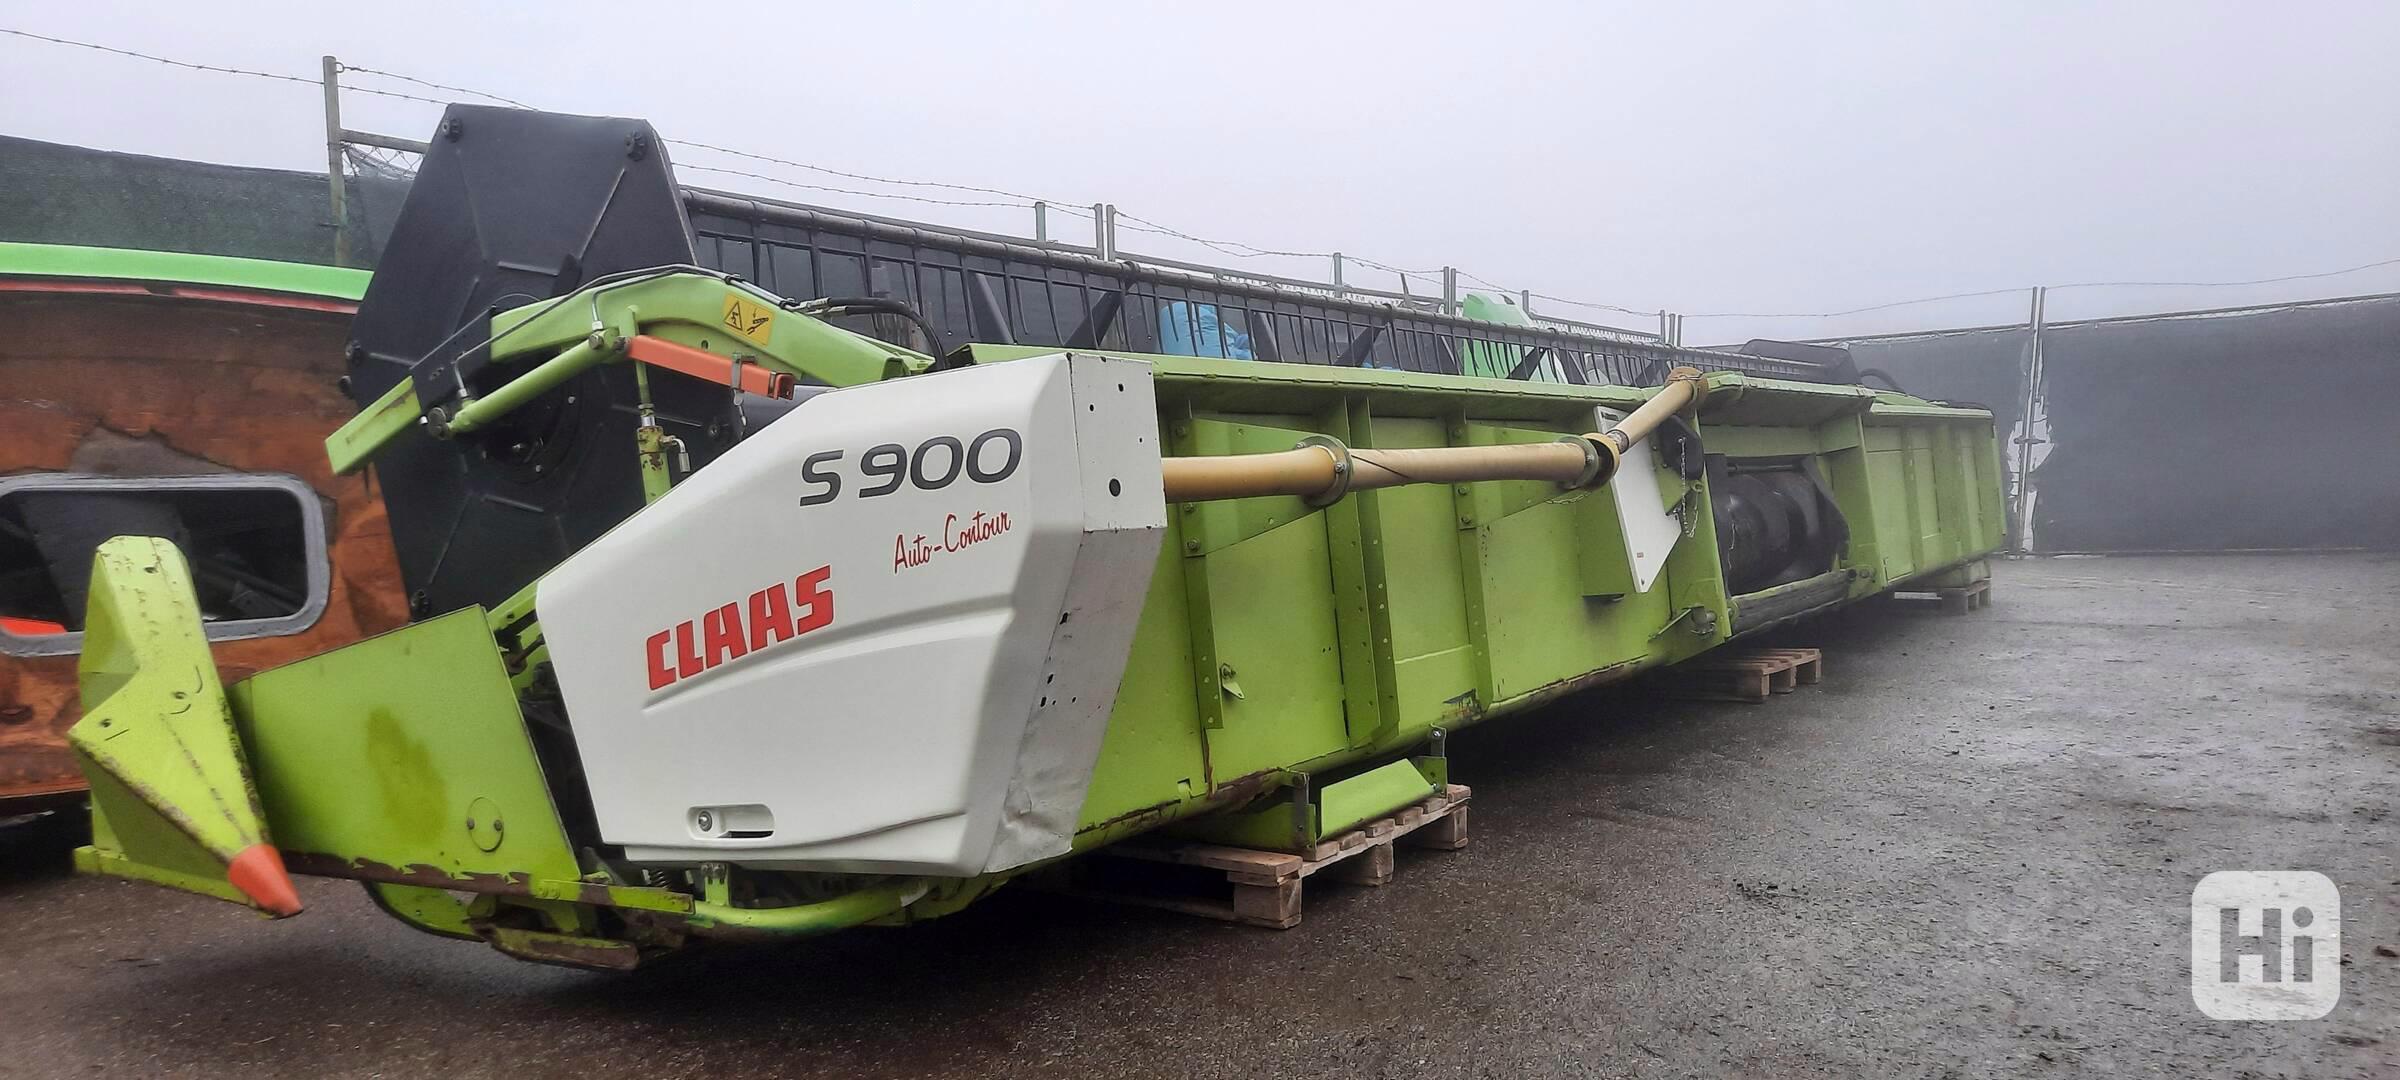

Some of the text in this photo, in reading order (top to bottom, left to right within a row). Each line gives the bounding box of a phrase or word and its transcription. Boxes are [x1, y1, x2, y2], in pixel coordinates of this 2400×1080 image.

[800, 428, 1023, 506] S 900
[893, 511, 1012, 574] Auto-Contour
[646, 565, 834, 690] CLAAS
